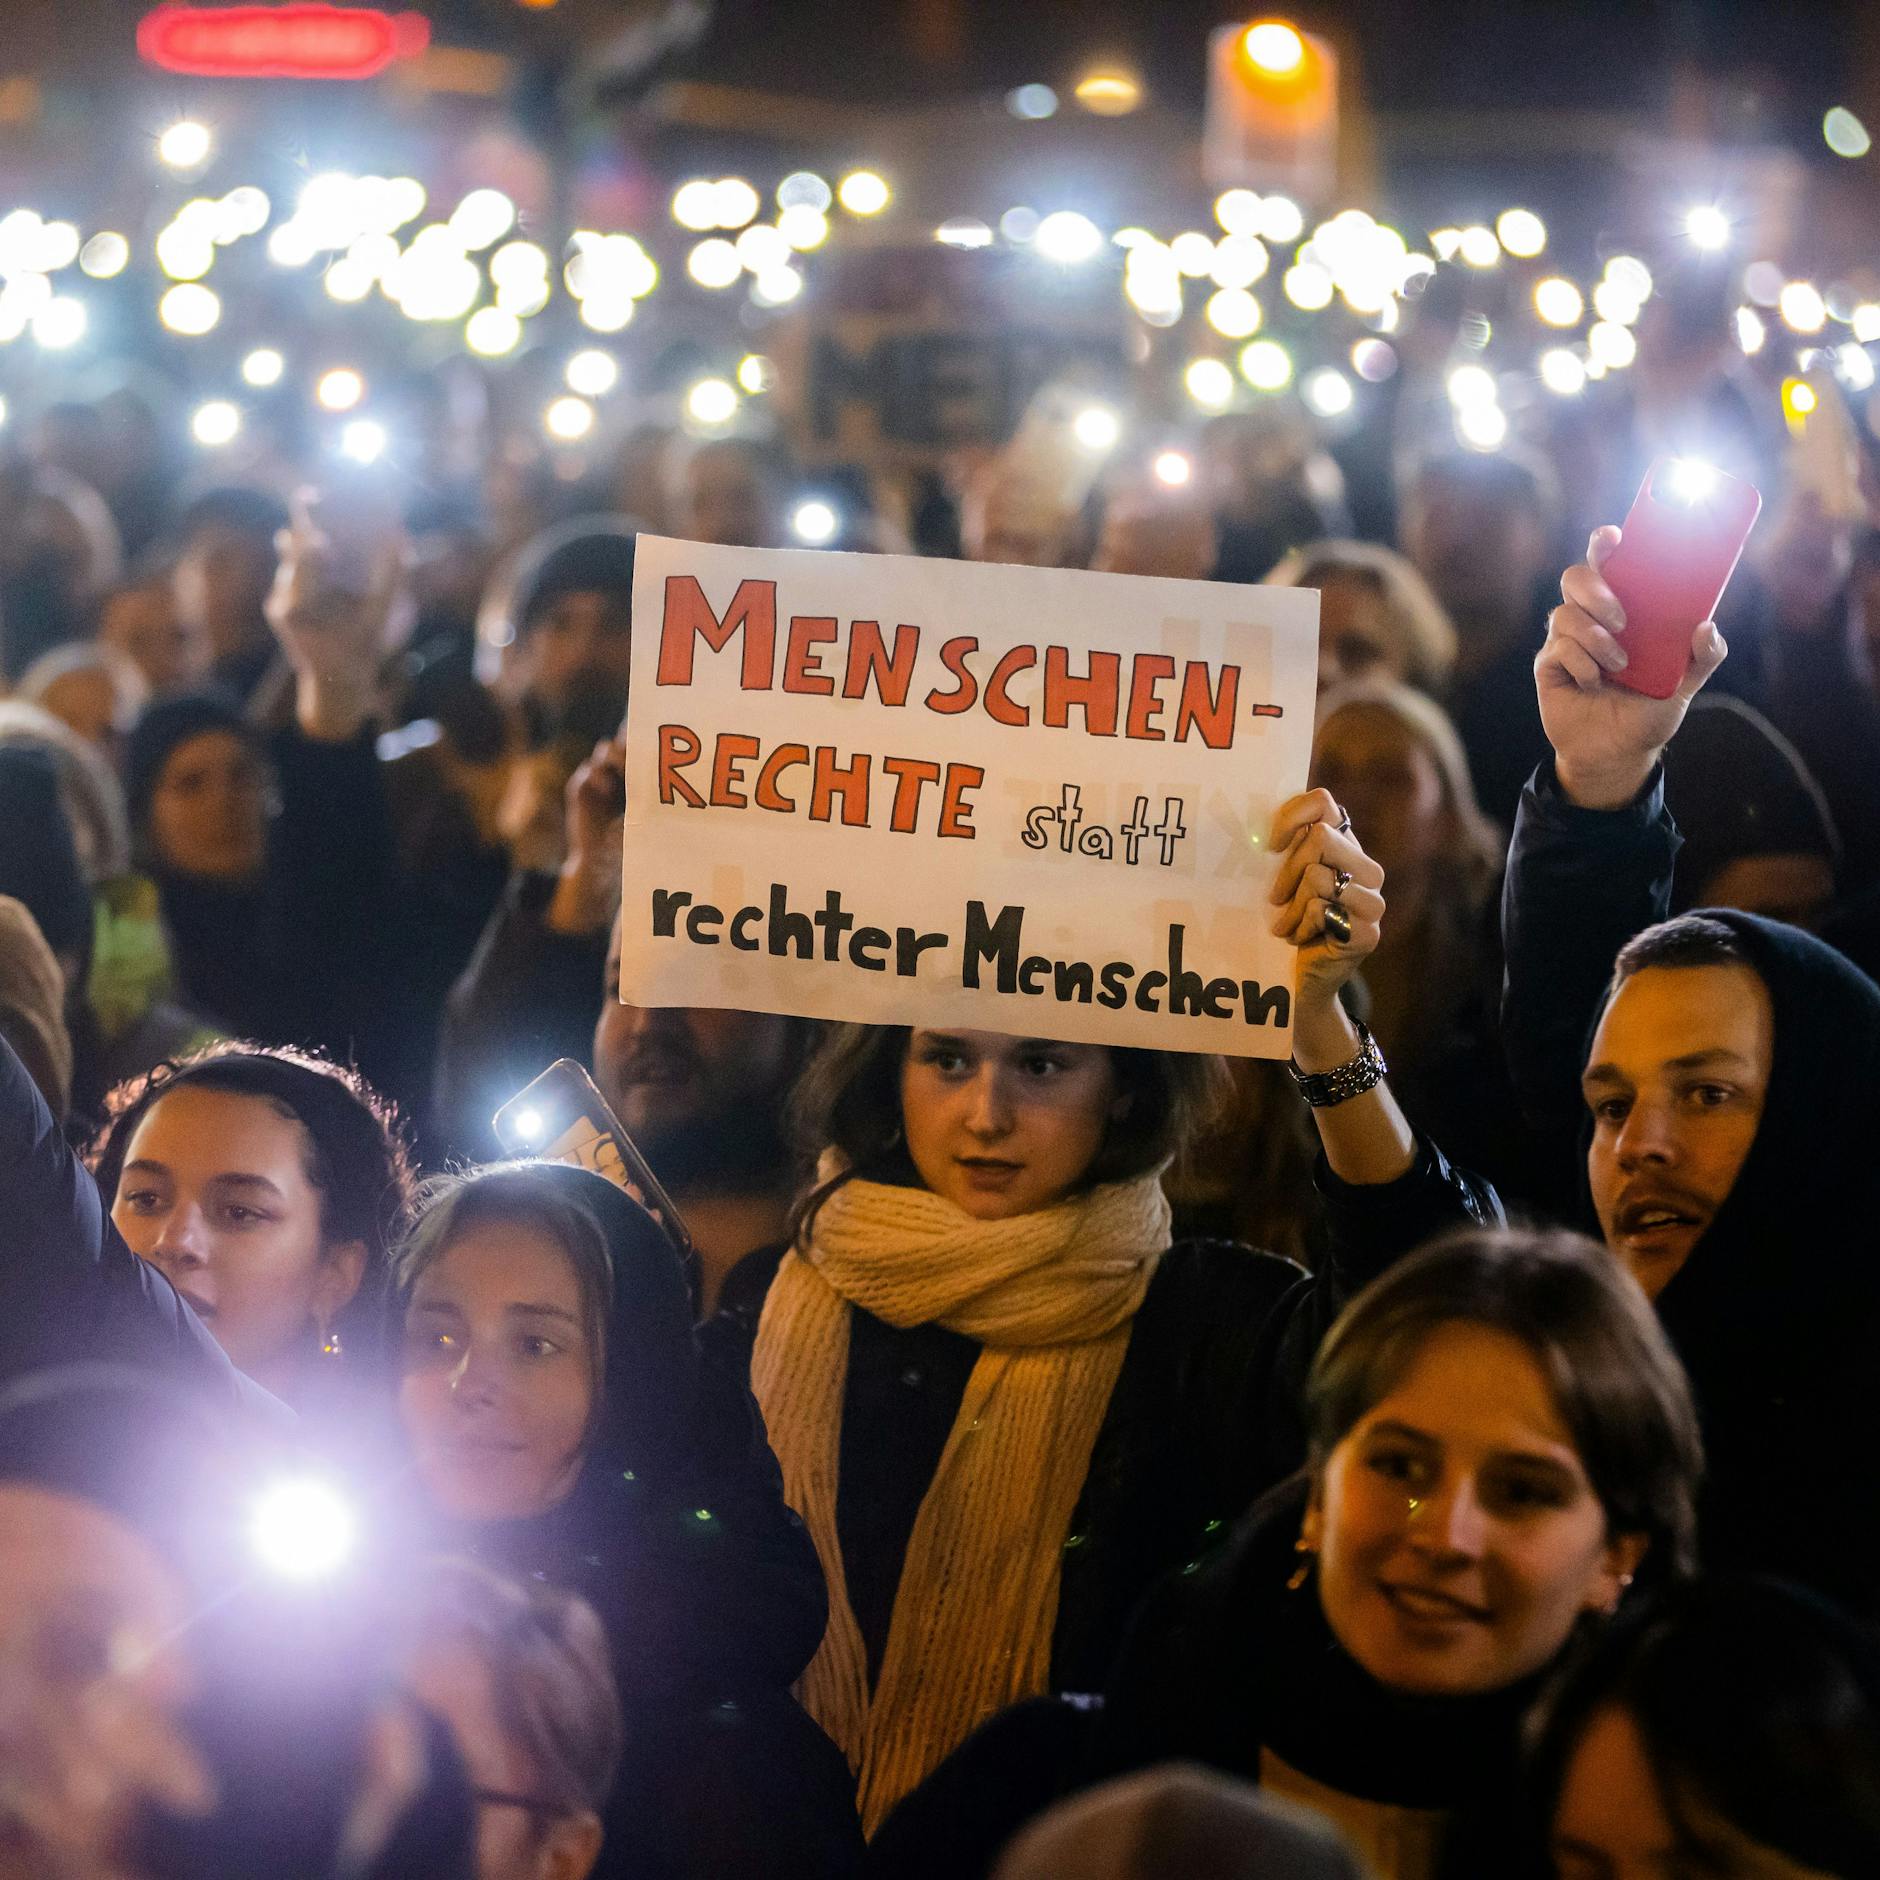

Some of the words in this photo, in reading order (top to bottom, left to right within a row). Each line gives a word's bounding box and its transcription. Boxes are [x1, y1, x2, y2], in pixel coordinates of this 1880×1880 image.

[656, 575, 1283, 750] MENSCHEN-
[658, 724, 985, 839] RECHTE
[1021, 783, 1186, 866] statt
[652, 883, 949, 977] rechter
[963, 900, 1291, 1028] Menschen
